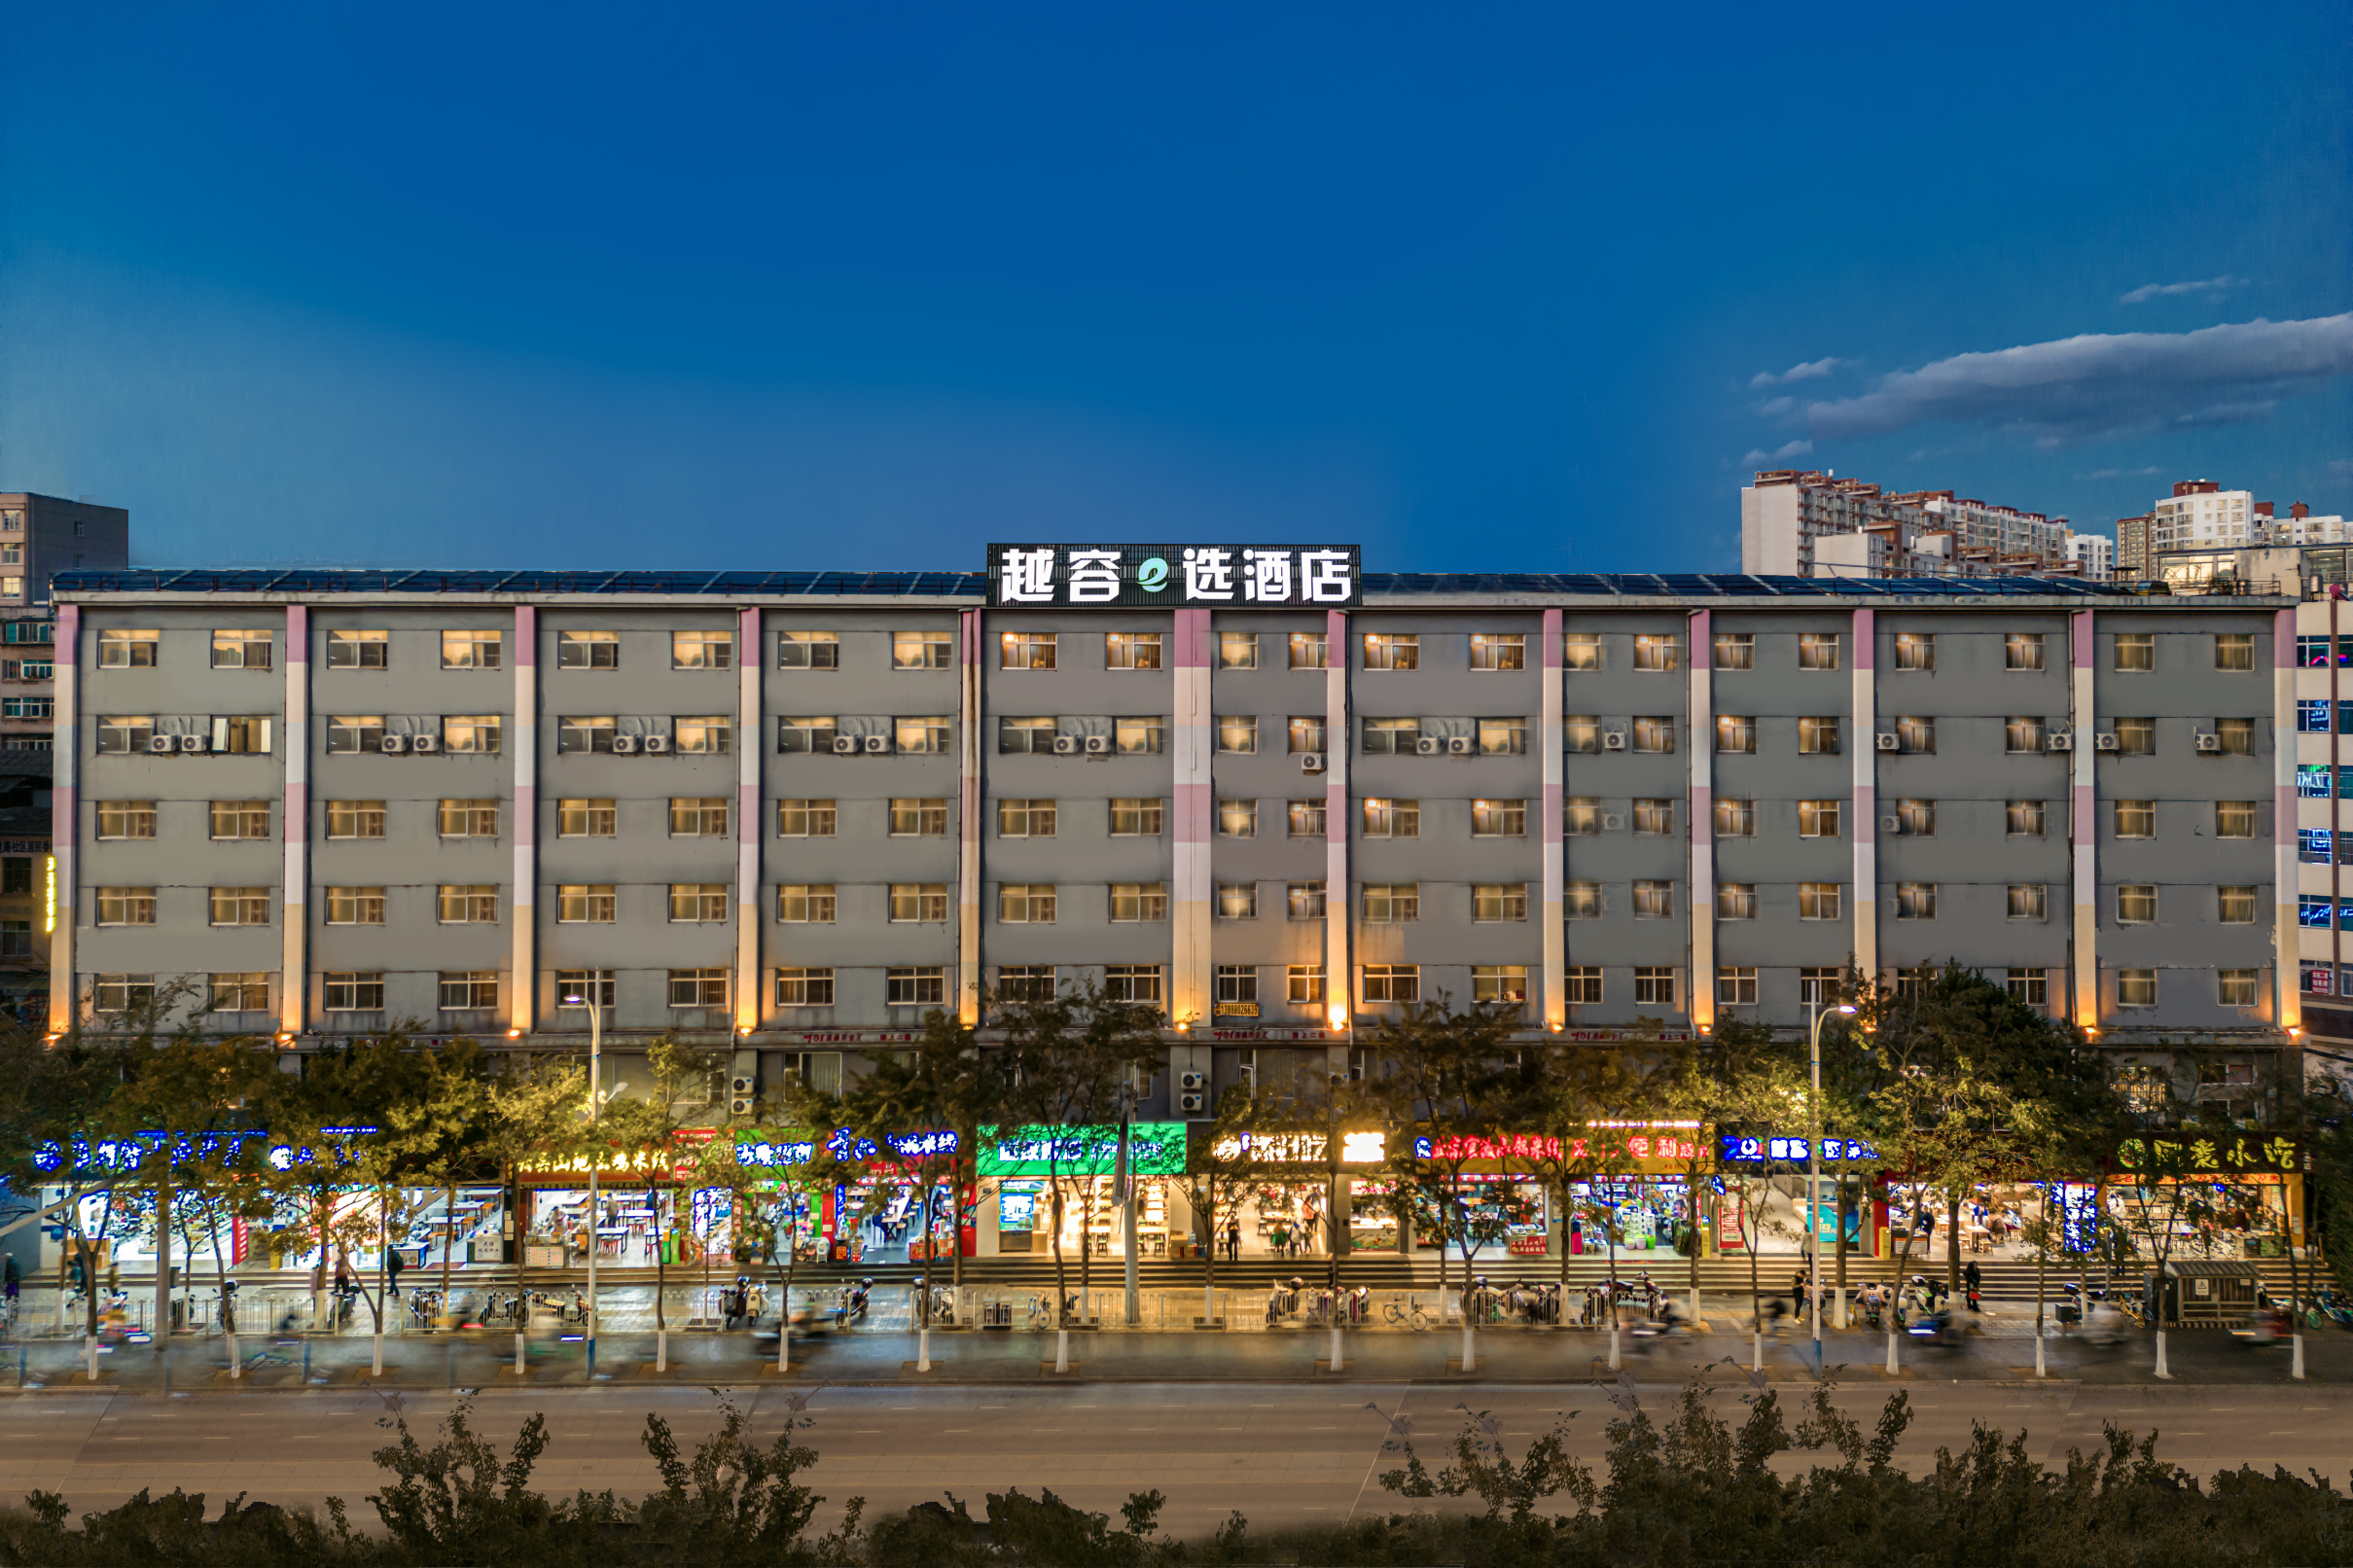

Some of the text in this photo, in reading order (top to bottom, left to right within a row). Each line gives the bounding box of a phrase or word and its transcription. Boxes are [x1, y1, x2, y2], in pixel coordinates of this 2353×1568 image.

[0, 840, 53, 853] 路社区居民委
